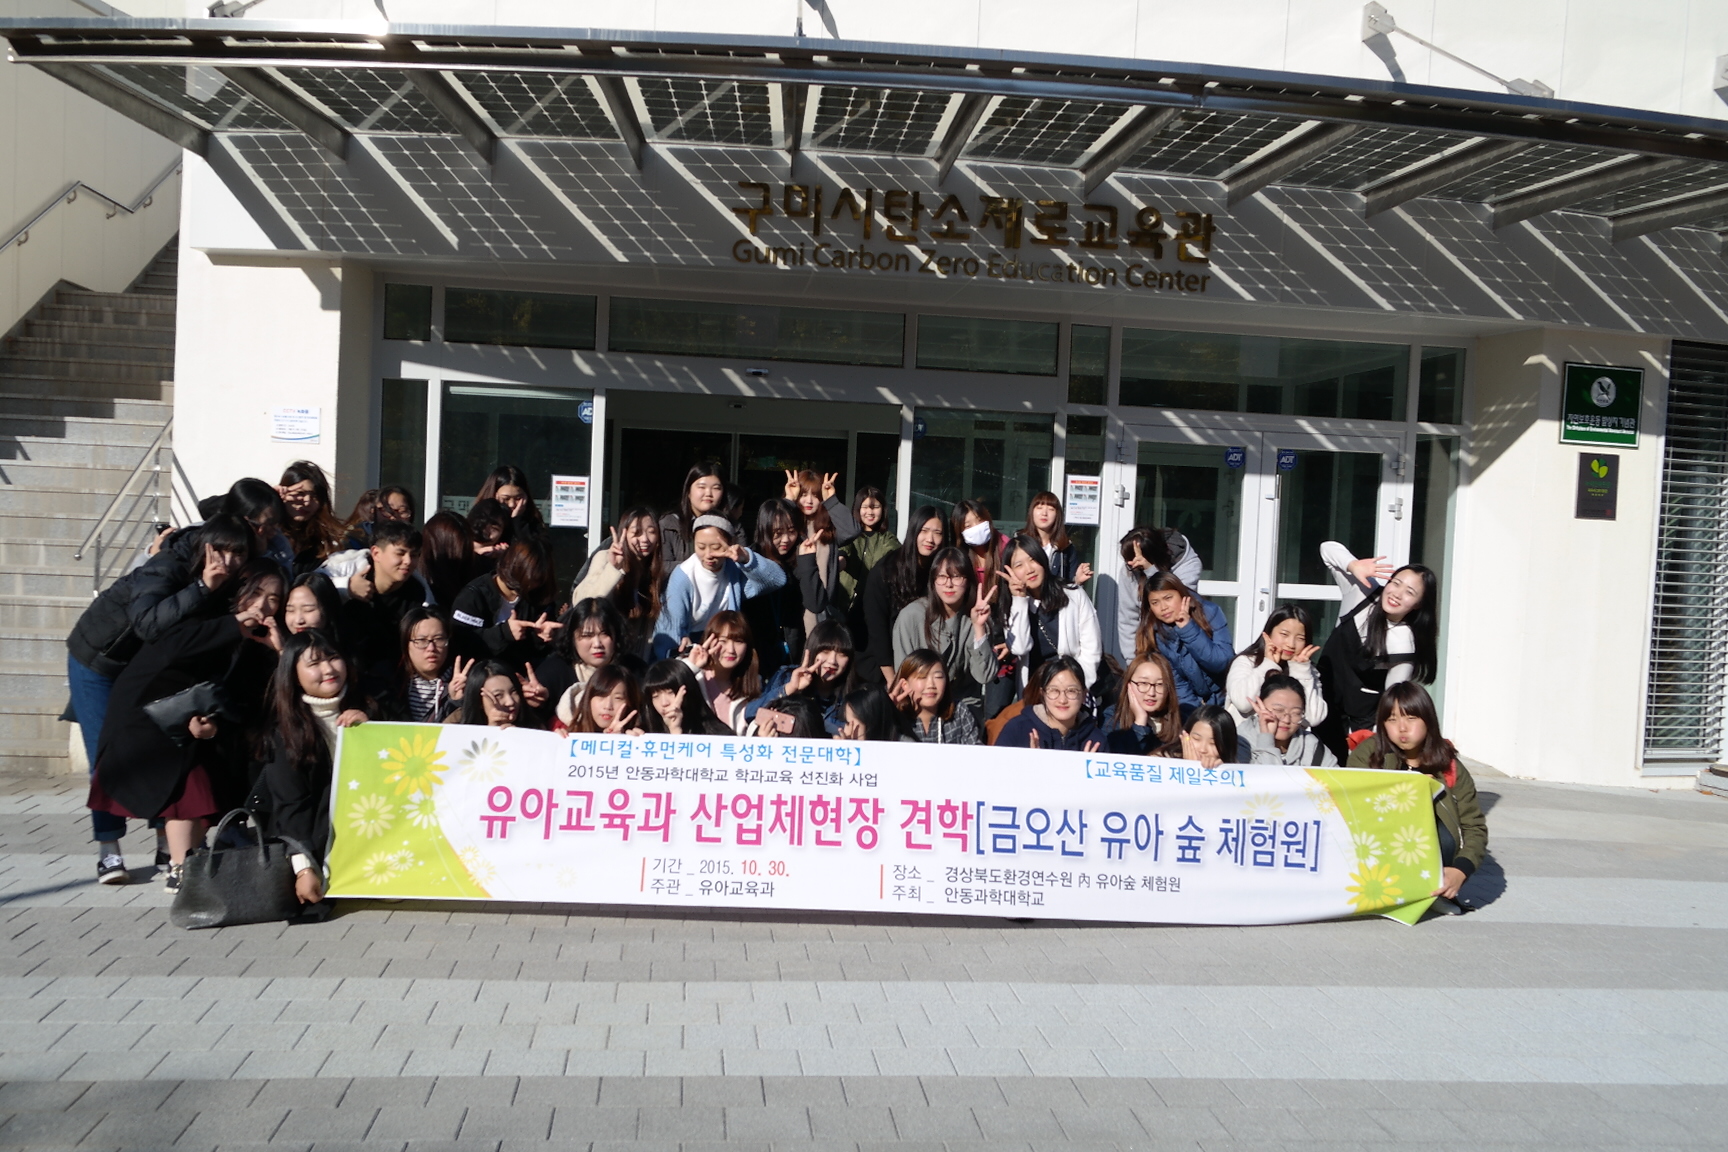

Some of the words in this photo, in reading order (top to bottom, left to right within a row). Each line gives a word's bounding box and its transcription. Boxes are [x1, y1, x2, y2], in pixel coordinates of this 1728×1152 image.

[731, 181, 1216, 264] 구미시탄소제로교육관
[732, 239, 804, 266] Gumi
[813, 242, 911, 273] Carbon
[919, 249, 979, 278] Zero
[986, 252, 1117, 287] Education
[1125, 263, 1211, 293] Center
[1228, 453, 1243, 462] ADT
[1280, 455, 1295, 464] ADT
[720, 743, 773, 762] 특성화
[568, 764, 619, 780] 2015년
[626, 766, 729, 782] 안동과학대학교
[735, 768, 793, 784] 학과교육
[799, 771, 843, 786] 선진화
[849, 773, 878, 788] 사업
[479, 785, 677, 843] 유아교육과
[689, 791, 885, 850] 산업체현장
[1100, 810, 1164, 863] 유아
[1175, 813, 1206, 864] 숲
[699, 860, 734, 875] 2015.
[741, 859, 761, 876] 10.
[768, 860, 790, 877] 30.
[699, 879, 775, 897] 유아교육과
[945, 866, 1073, 888] 경상북도환경연수원
[1096, 873, 1136, 891] 유아숲
[1141, 875, 1181, 893] 체험원
[945, 887, 1045, 906] 안동과학대학교
